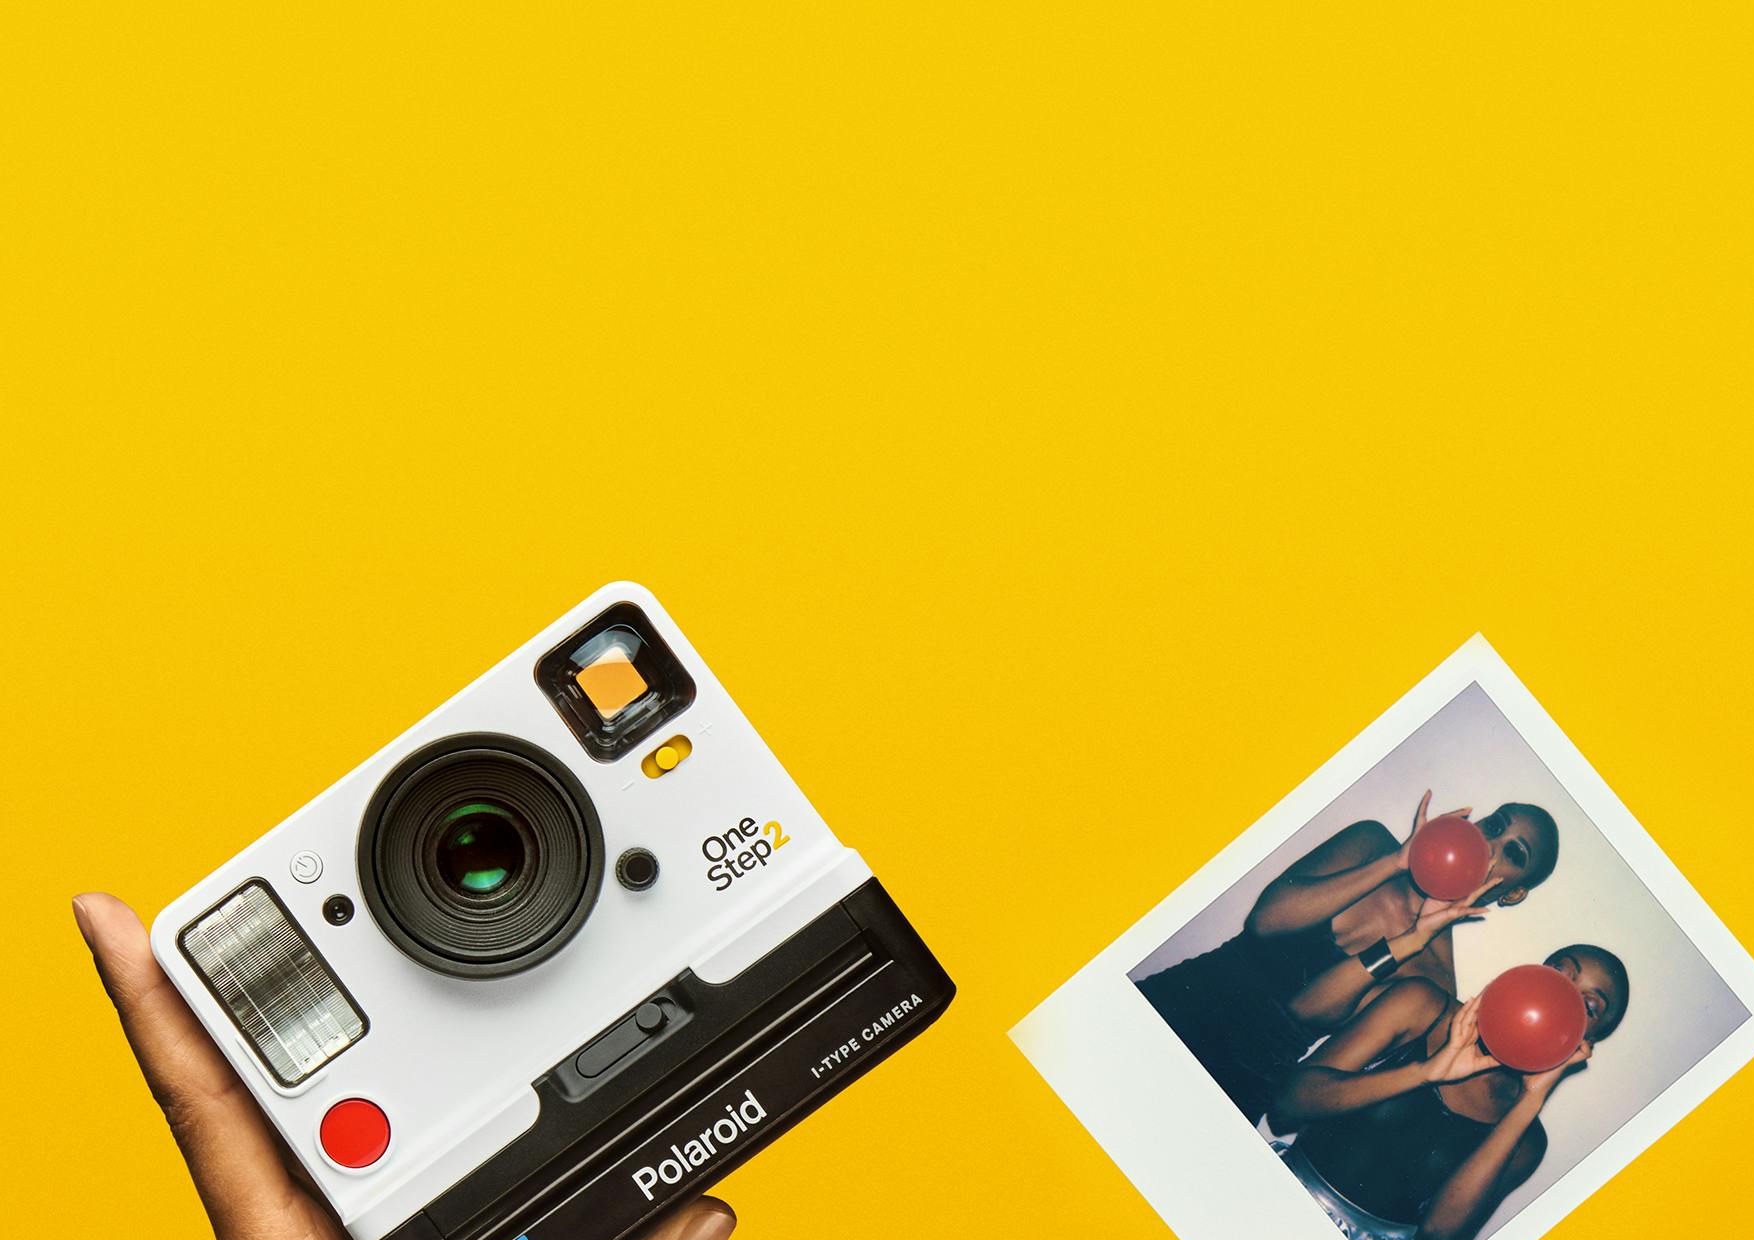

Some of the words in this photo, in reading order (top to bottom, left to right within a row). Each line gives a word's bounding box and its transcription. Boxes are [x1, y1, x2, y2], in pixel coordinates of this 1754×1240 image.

[702, 817, 759, 862] One
[810, 1037, 861, 1079] I-TYPE
[861, 992, 923, 1042] CAMERA
[631, 1089, 768, 1201] Polaroid
